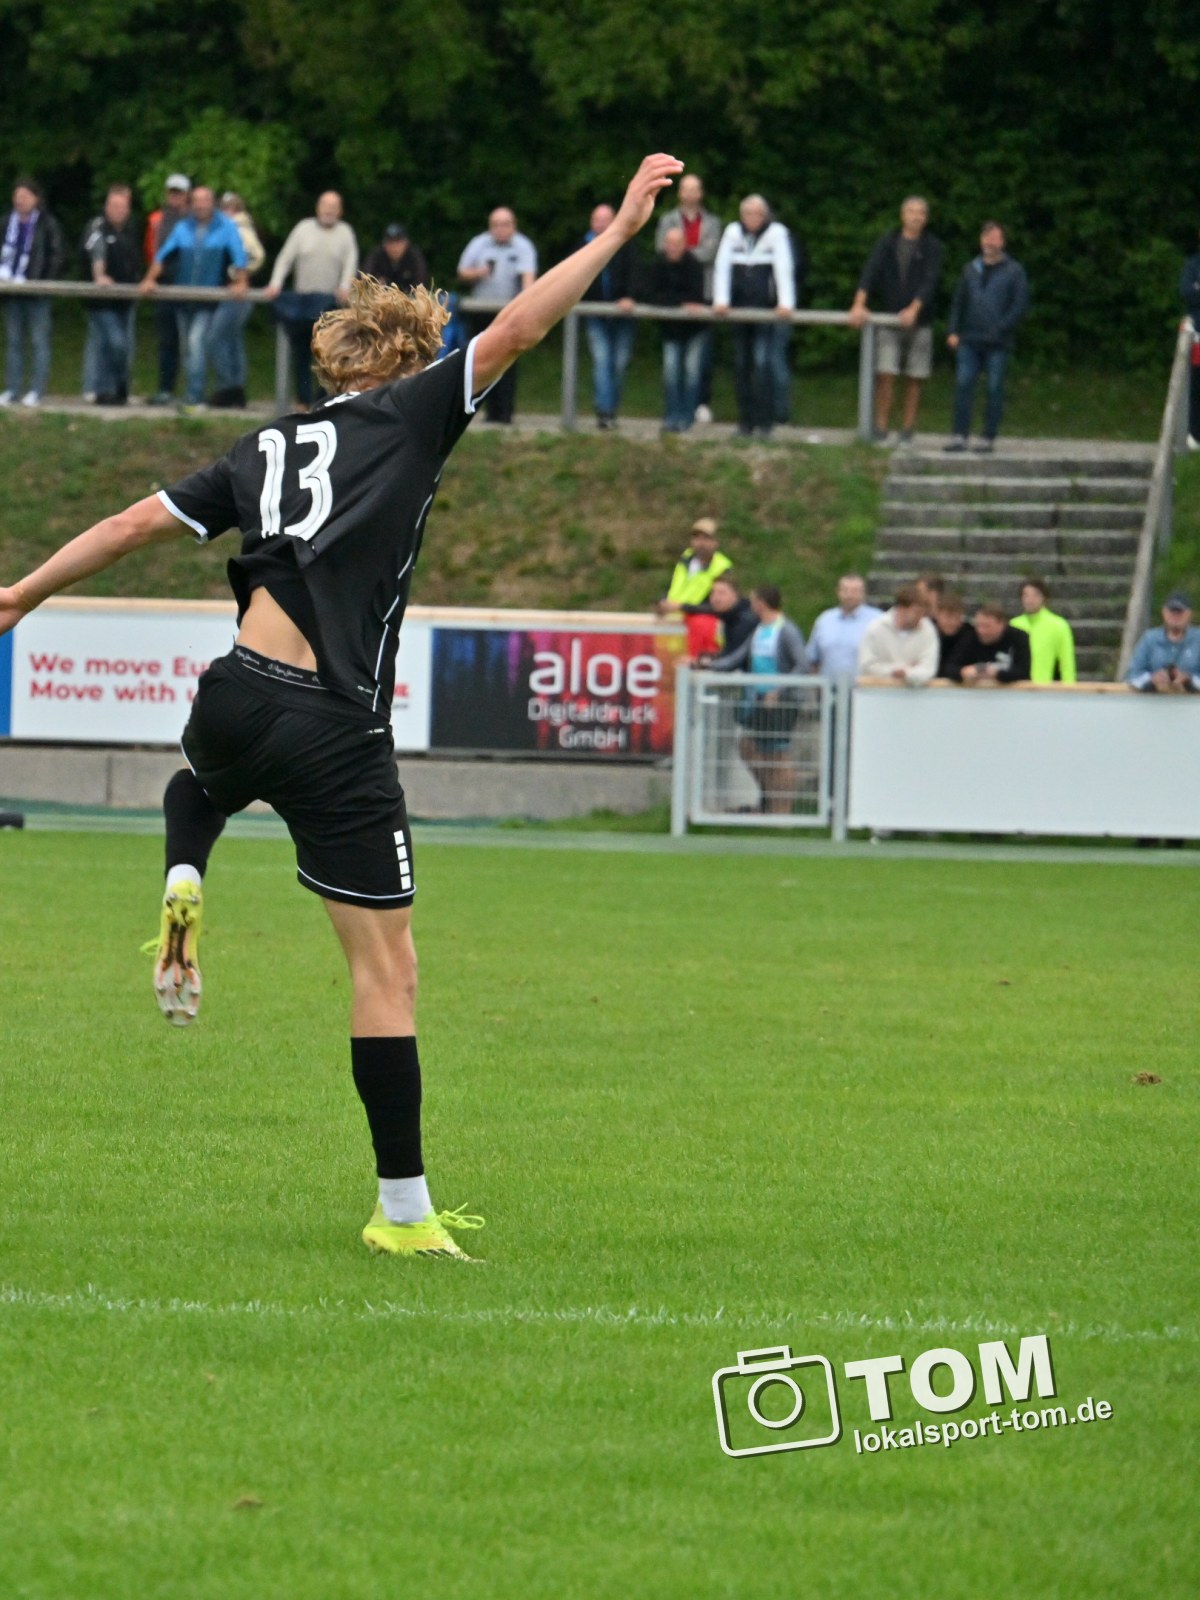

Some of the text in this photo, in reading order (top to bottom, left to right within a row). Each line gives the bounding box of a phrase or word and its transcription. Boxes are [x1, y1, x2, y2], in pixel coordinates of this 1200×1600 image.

[257, 420, 338, 541] 13
[30, 653, 209, 678] We move Eu
[529, 637, 662, 697] aloe
[30, 680, 103, 701] Move
[114, 680, 176, 703] with
[527, 697, 658, 726] Digitaldruck
[558, 725, 628, 749] GmbH
